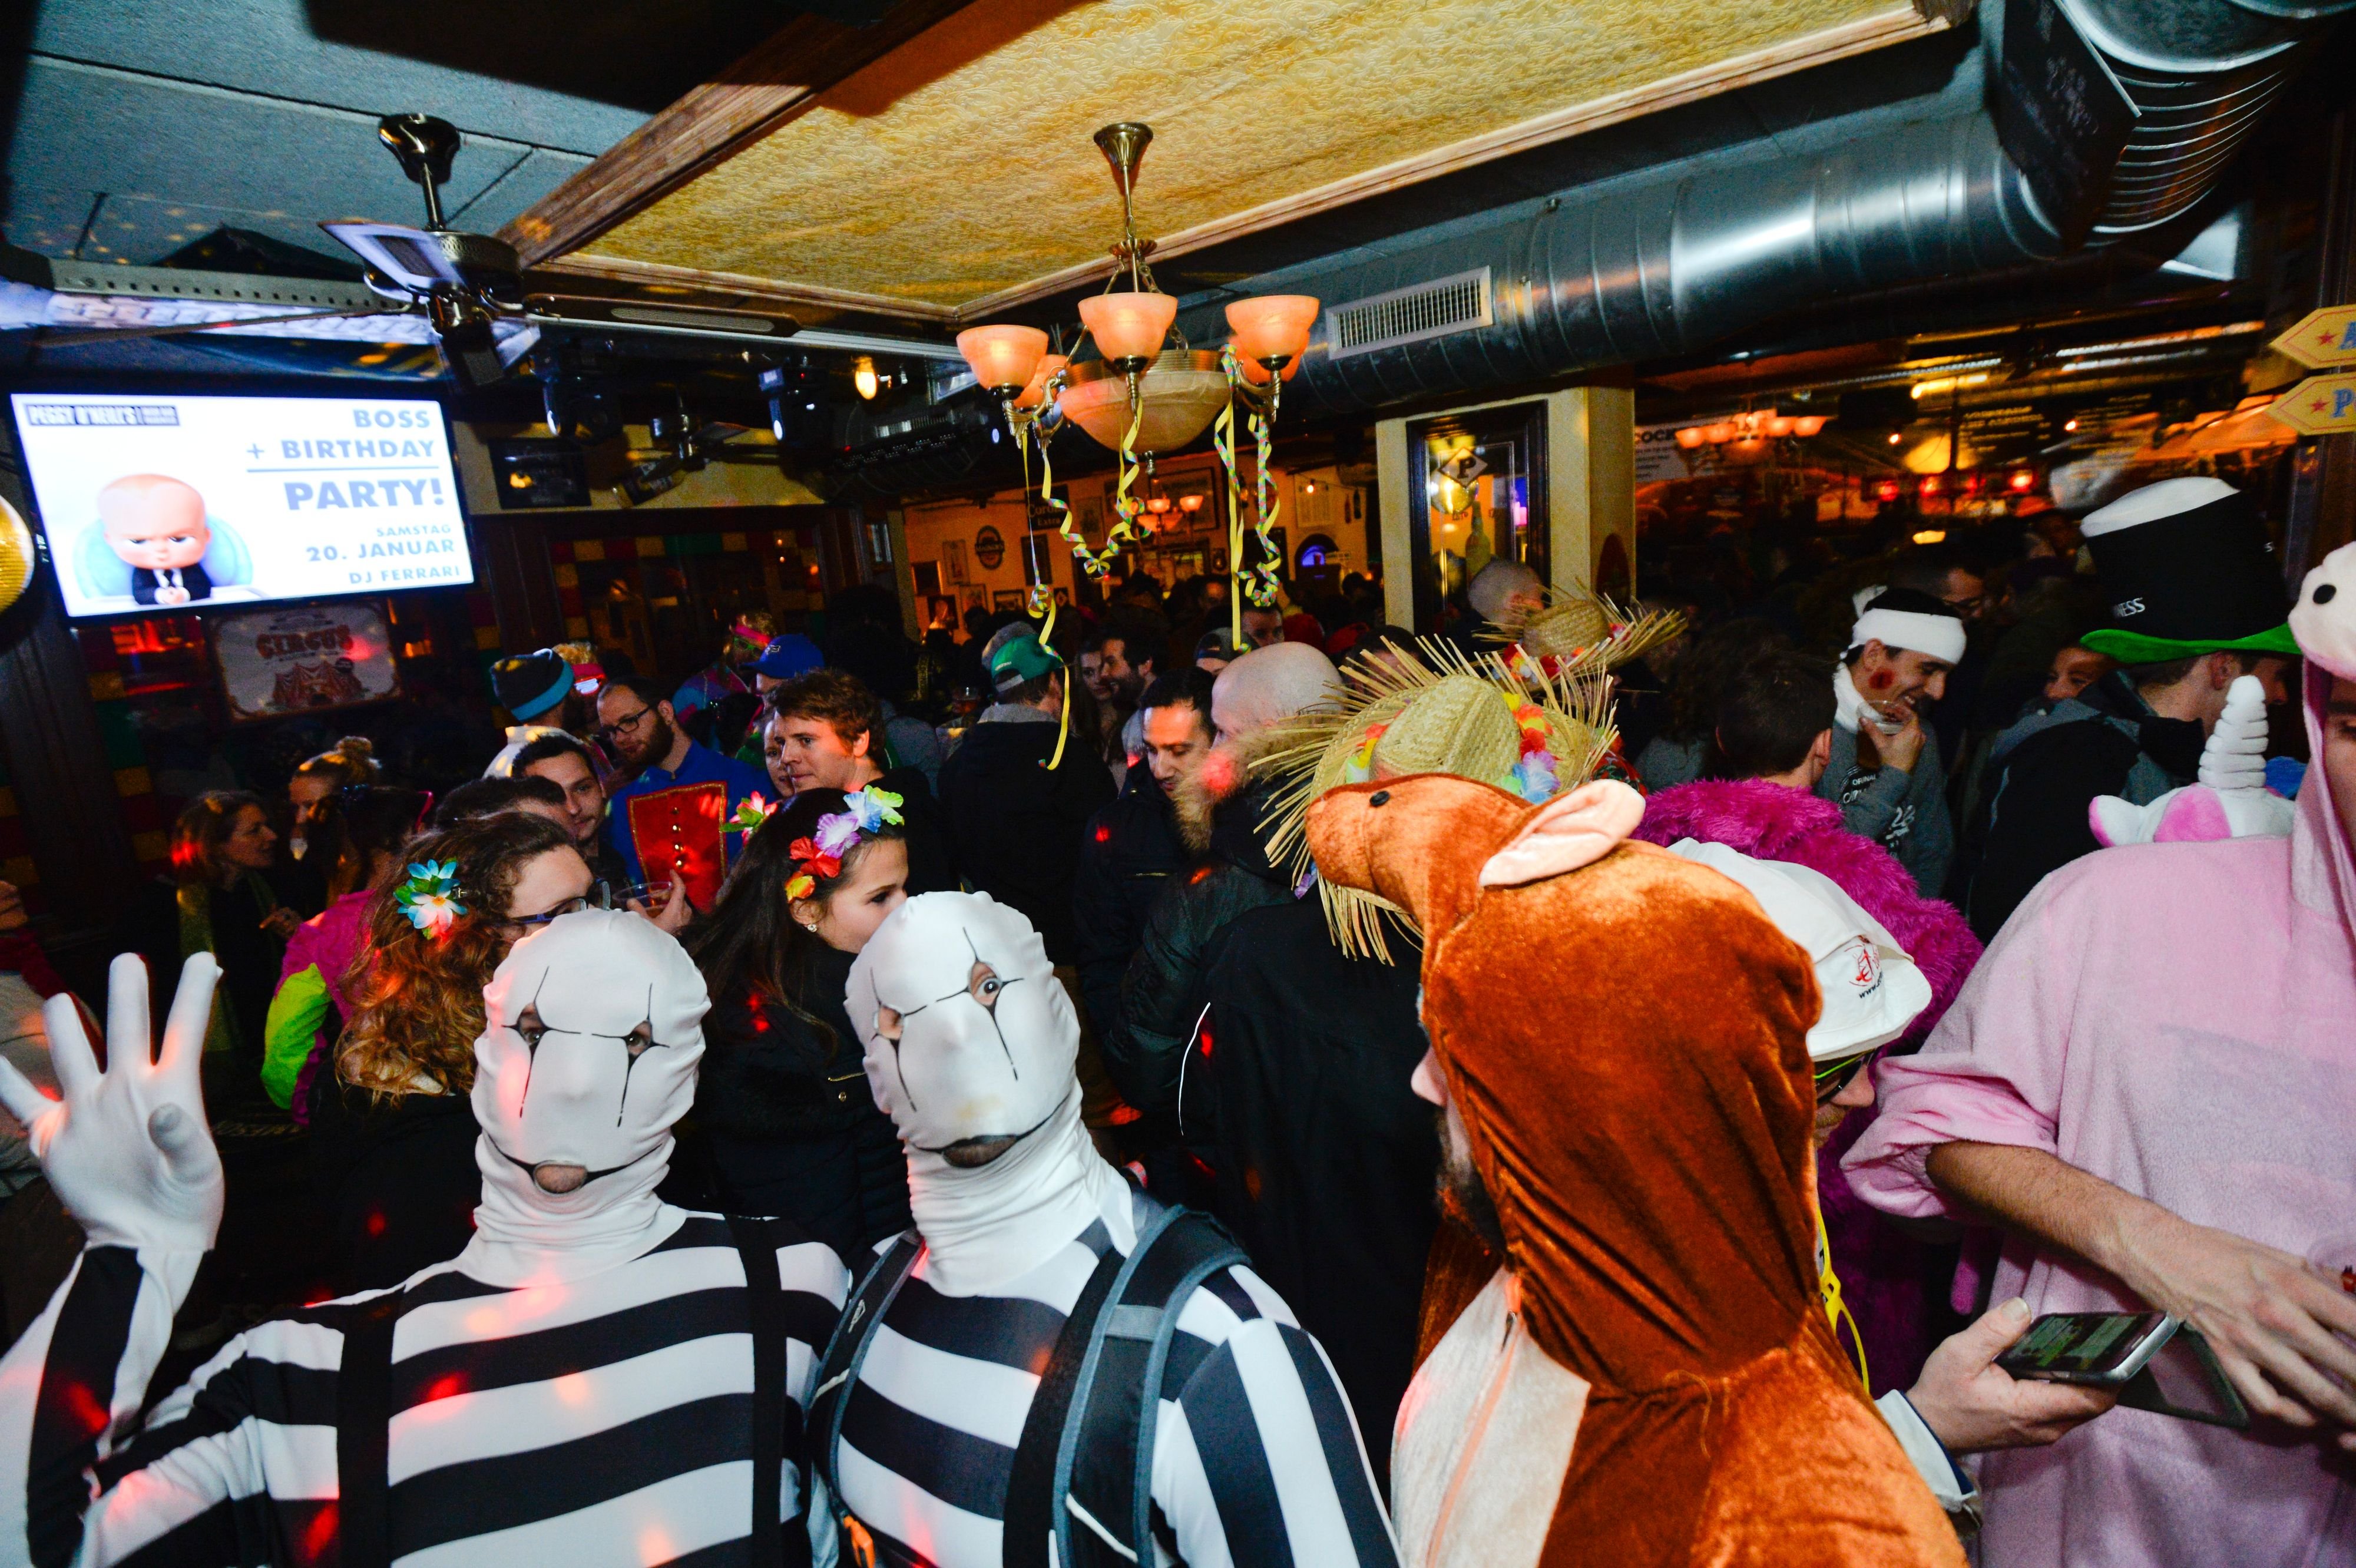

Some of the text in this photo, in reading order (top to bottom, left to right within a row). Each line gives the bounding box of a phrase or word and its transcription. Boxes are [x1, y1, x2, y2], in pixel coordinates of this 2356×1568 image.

[353, 409, 431, 428] BOSS
[247, 439, 434, 459] + BIRTHDAY
[1457, 457, 1477, 478] P
[283, 478, 445, 511] PARTY!
[376, 524, 452, 537] SAMSTAG
[306, 539, 455, 562] 20. JANUAR
[349, 565, 461, 584] DJ FERRARI
[257, 624, 353, 659] CIRCUS
